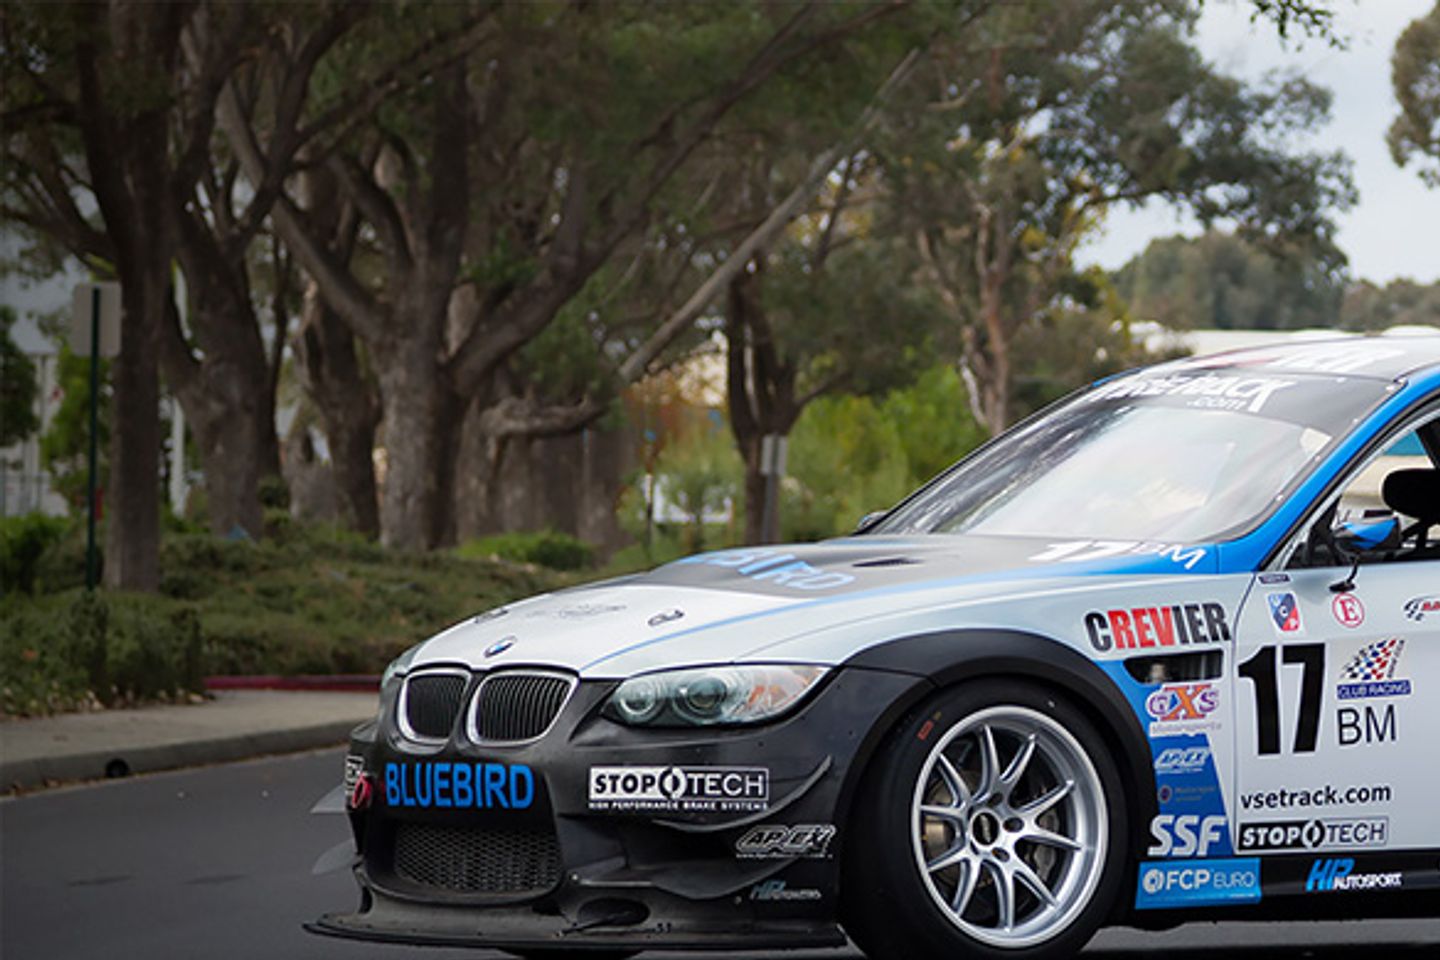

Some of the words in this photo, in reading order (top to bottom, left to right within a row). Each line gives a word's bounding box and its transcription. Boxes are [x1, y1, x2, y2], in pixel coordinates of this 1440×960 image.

[1085, 603, 1231, 652] CREVIER
[1238, 643, 1325, 756] 17
[1338, 685, 1367, 698] CLUB
[1369, 682, 1410, 695] RACING
[1337, 704, 1396, 746] BM
[386, 762, 534, 809] BLUEBIRD
[1241, 785, 1391, 808] vsetrack.com
[1147, 815, 1227, 857] SSF
[1166, 869, 1210, 890] FCP
[1213, 871, 1256, 888] EURO
[1305, 858, 1355, 892] HP
[1333, 873, 1402, 890] AUTOSPORT
